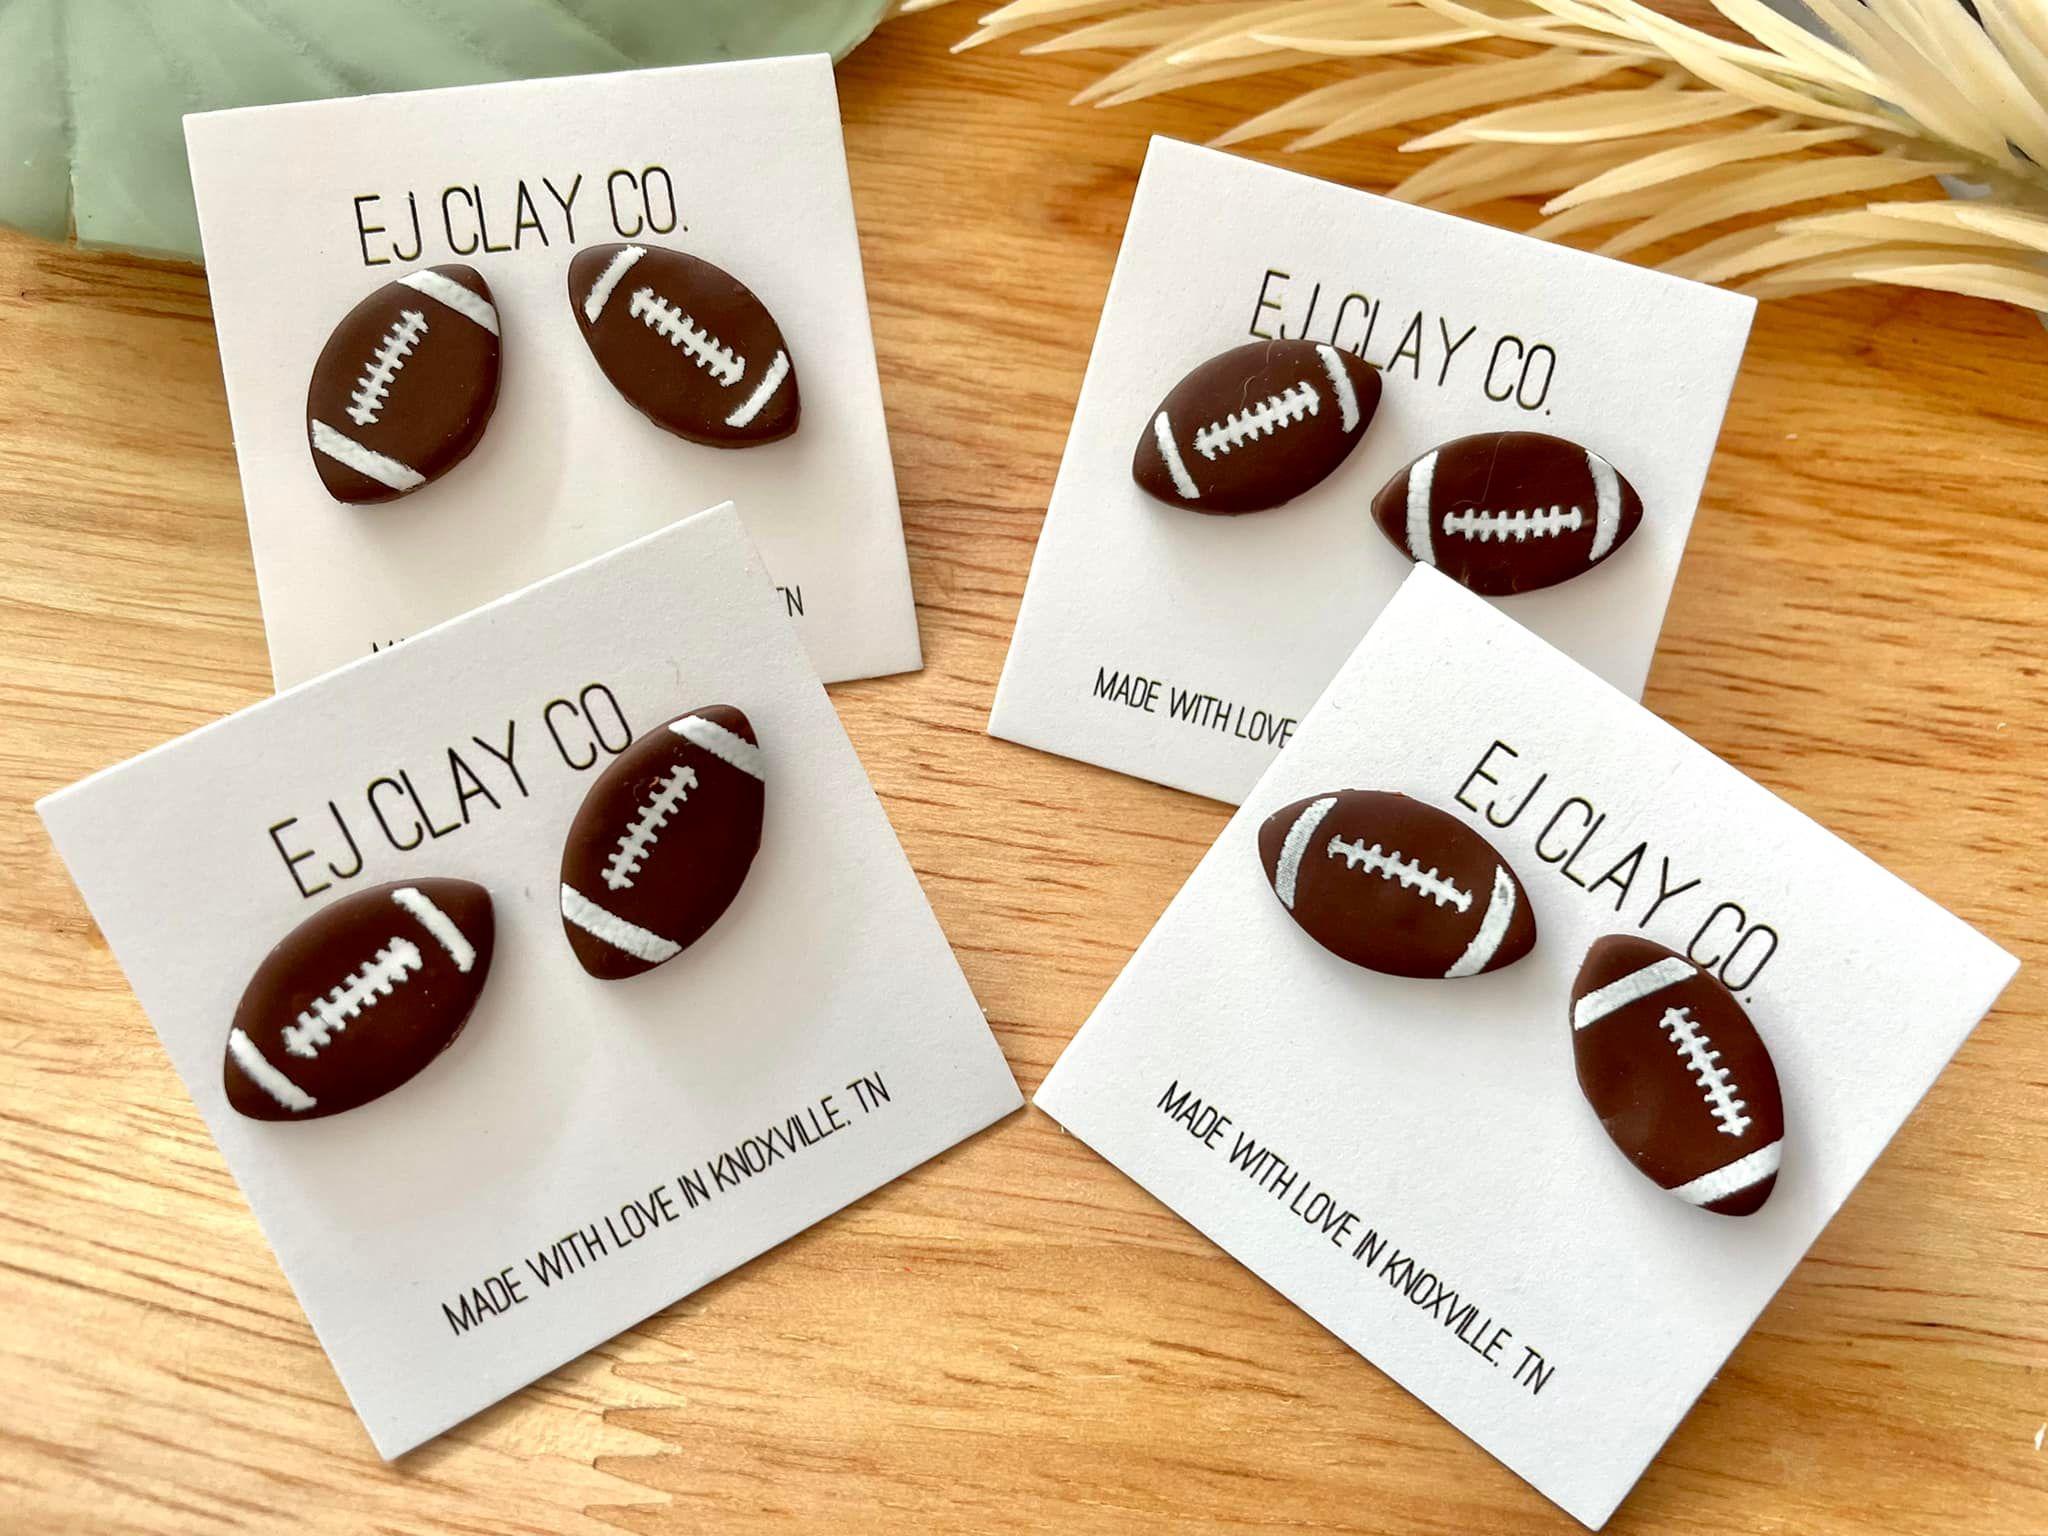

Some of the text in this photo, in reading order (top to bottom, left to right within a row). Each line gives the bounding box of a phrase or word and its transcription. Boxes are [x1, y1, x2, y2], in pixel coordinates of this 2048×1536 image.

[354, 166, 689, 266] EJ CLAY CO.
[1249, 269, 1557, 415] EJ CLAY CO.
[775, 585, 804, 617] N
[269, 683, 632, 898] EJ CLAY CO
[1093, 666, 1297, 749] MADE WITH LOVE
[1454, 740, 1778, 1003] EJ CLAY CO.
[442, 1267, 529, 1336] MADE
[526, 1225, 609, 1287] WITH
[604, 1185, 680, 1249] LOVE
[677, 1169, 711, 1208] IN
[846, 1071, 891, 1113] TN
[1157, 1080, 1232, 1150] MADE
[1229, 1131, 1298, 1200] WITH
[1289, 1181, 1360, 1248] LOVE
[1352, 1228, 1388, 1268] IN
[1512, 1345, 1556, 1395] TN
